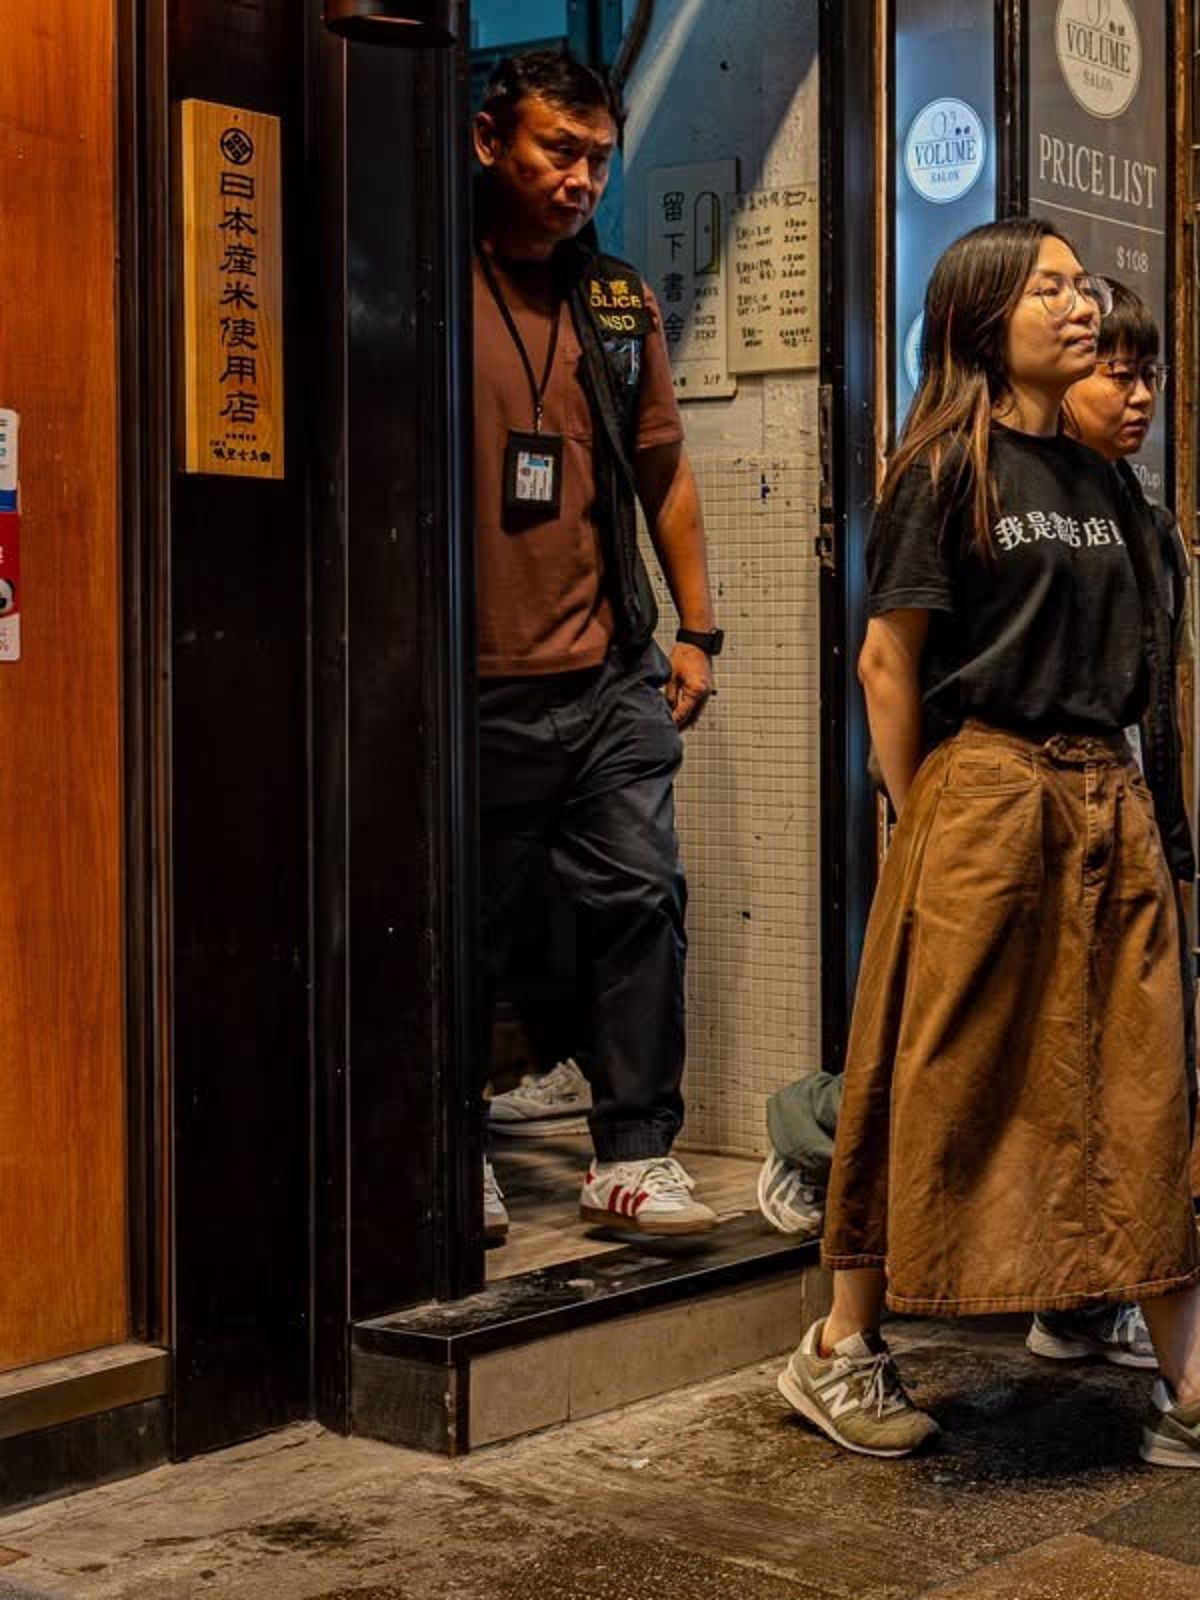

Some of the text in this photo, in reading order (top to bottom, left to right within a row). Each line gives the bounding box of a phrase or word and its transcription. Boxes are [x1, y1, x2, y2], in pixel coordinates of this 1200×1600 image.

[1066, 23, 1131, 74] VOLUME
[915, 139, 977, 166] VOLUME
[1040, 133, 1157, 209] PRICE LIST
[590, 295, 642, 309] OLICE
